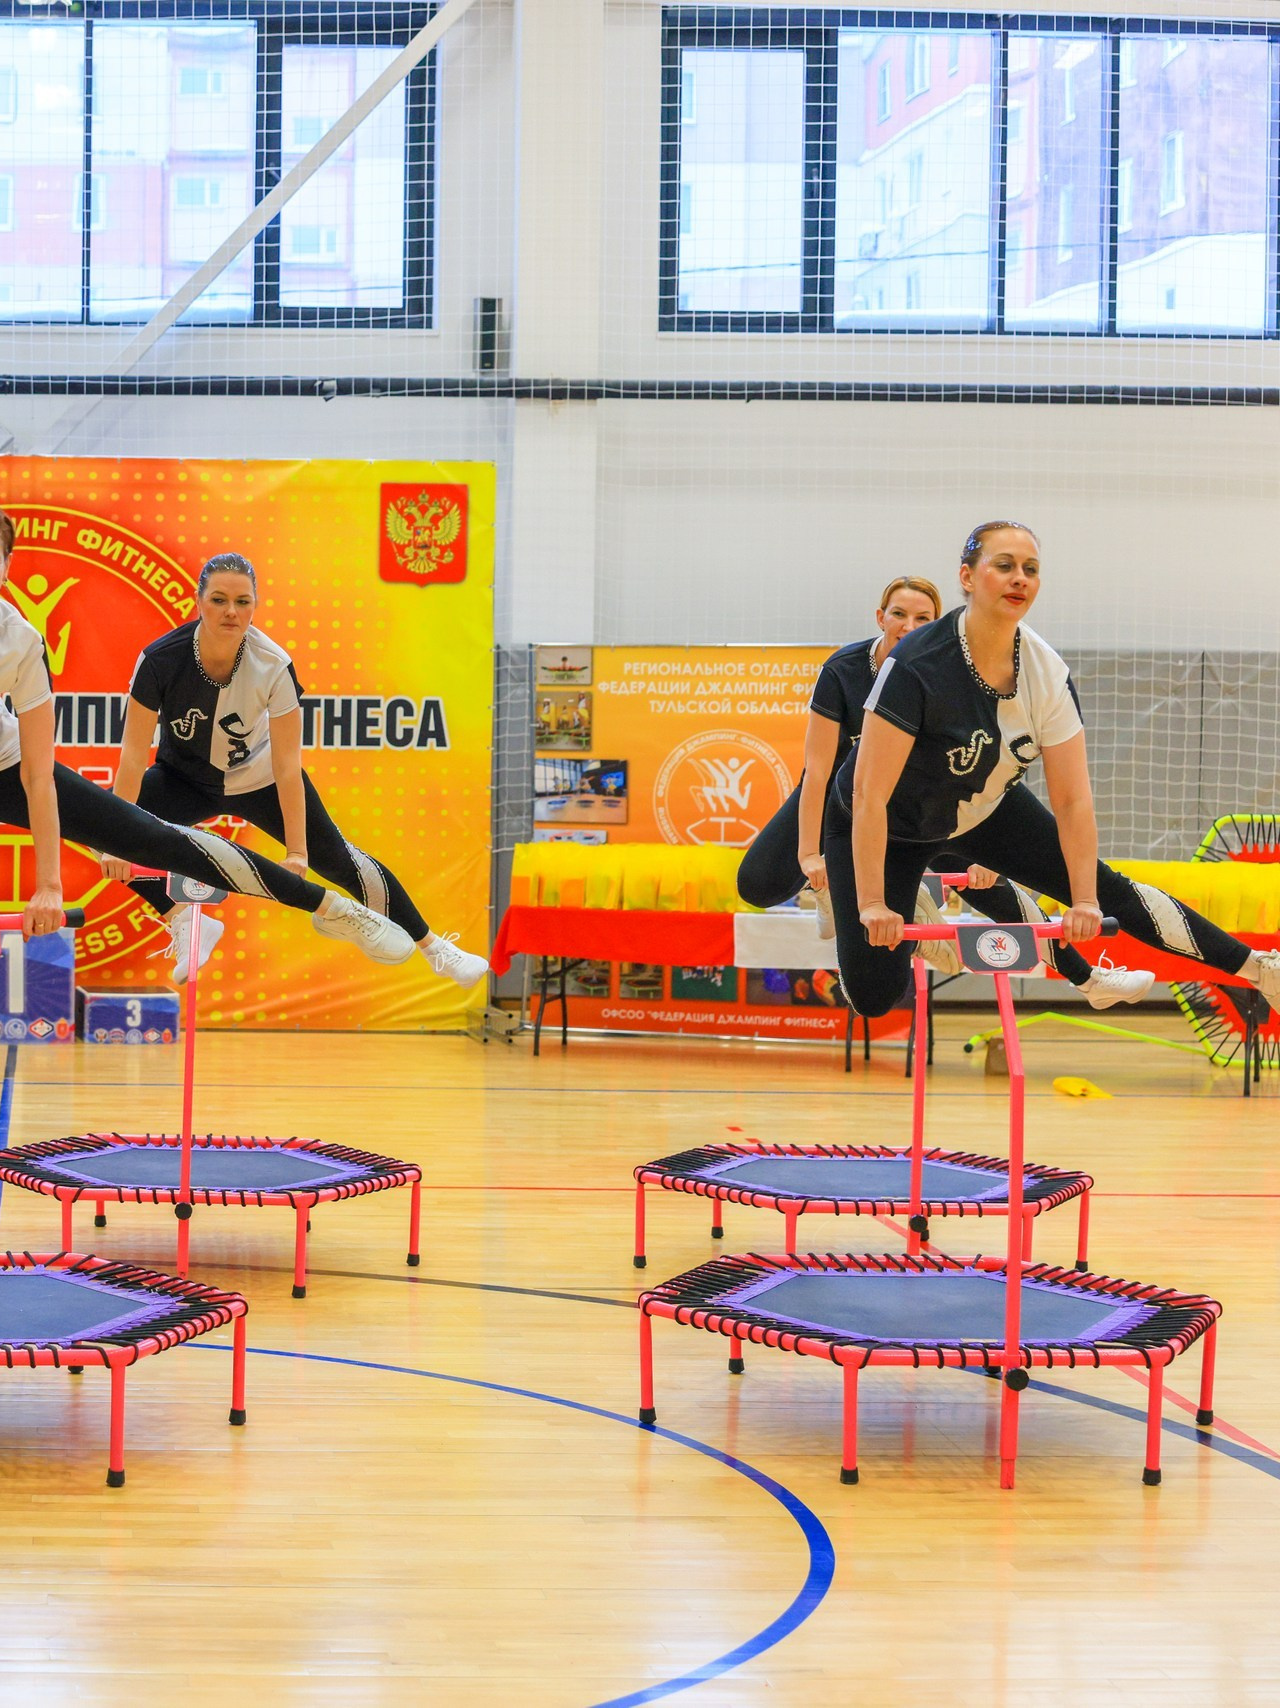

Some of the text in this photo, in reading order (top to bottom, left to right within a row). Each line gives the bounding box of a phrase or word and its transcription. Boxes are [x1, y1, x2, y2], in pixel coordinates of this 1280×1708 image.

[77, 528, 195, 619] ФИТНЕСА
[623, 662, 821, 678] РЕГИОНАЛЬНОЕ ОТДЕЛЕН
[598, 681, 690, 696] ФЕДЕРАЦИИ
[695, 682, 788, 696] ДЖАМПИНГ
[649, 698, 811, 715] ТУЛЬСКОЙ ОБЛАСТИ
[298, 696, 449, 749] ТНЕСА
[2, 934, 24, 1014] 1
[126, 999, 142, 1027] 3
[601, 1008, 839, 1029] ОФСОО "ФЕДЕРАЦИЯ ДЖАМПИНГ ФИТНЕСА"
